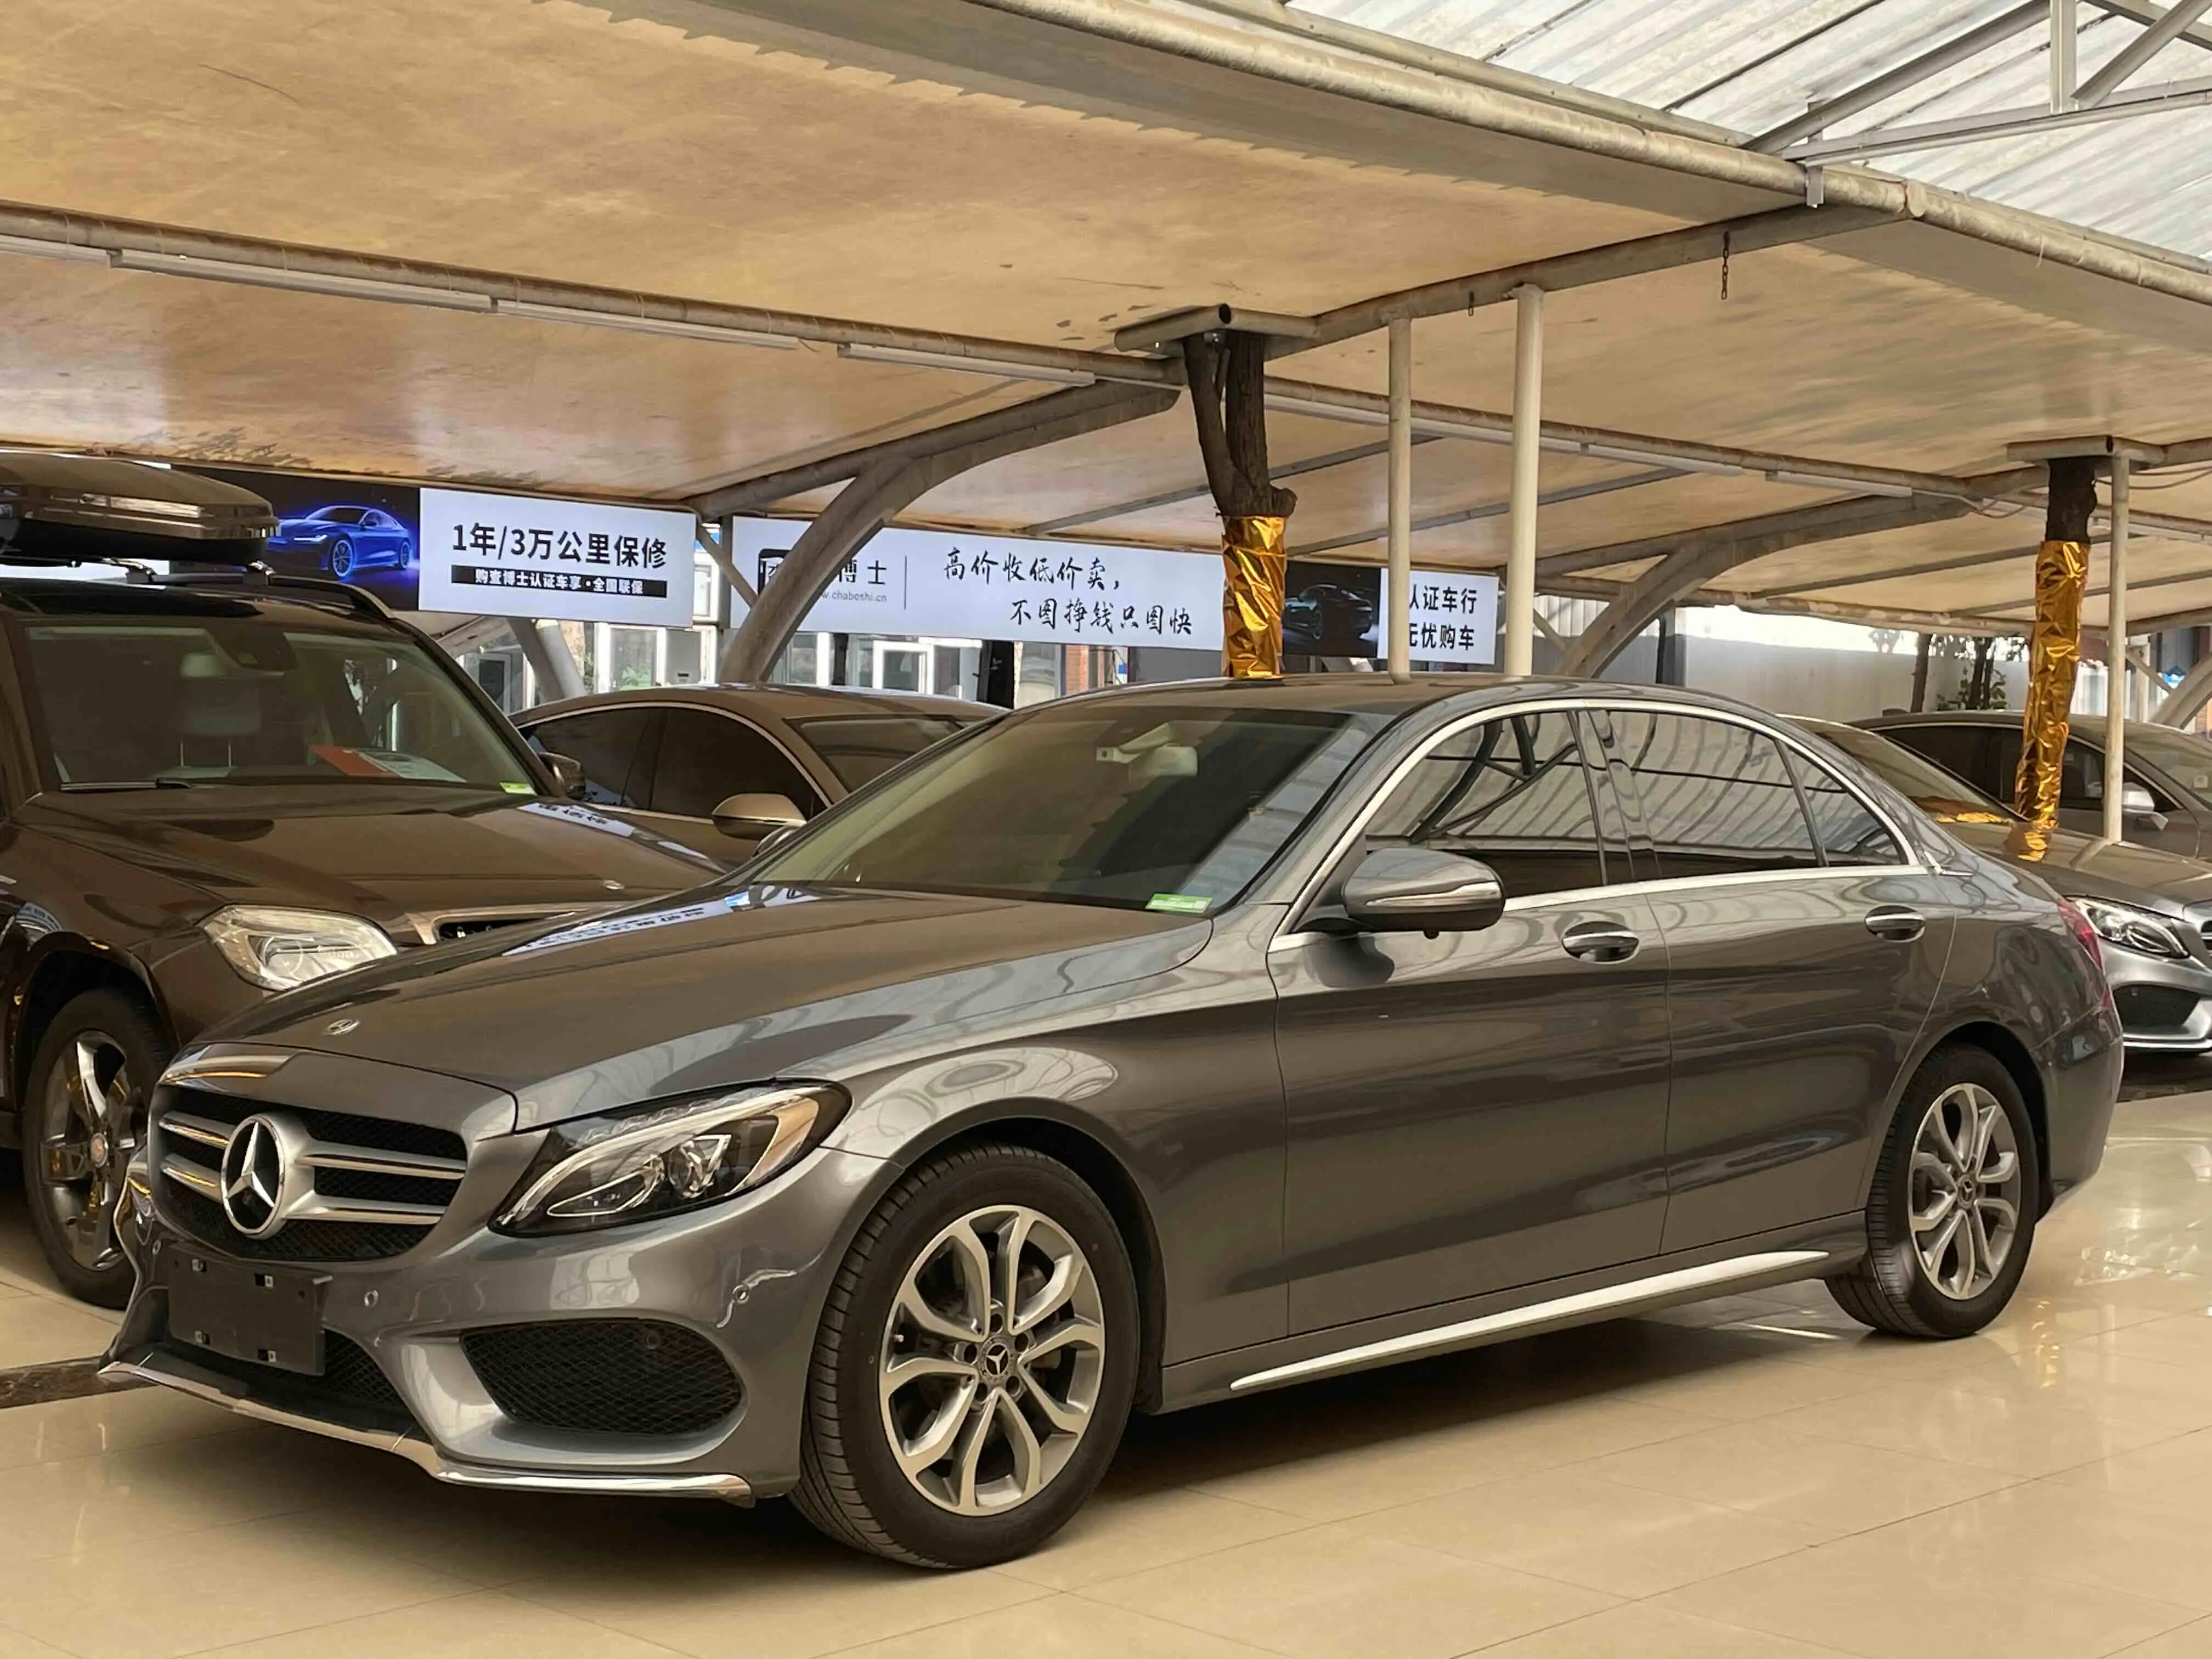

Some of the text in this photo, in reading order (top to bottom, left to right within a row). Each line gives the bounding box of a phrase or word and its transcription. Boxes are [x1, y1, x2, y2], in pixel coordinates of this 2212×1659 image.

[453, 522, 667, 569] 1年/3万公里保修
[1009, 597, 1193, 635] 不图挣钱只图快
